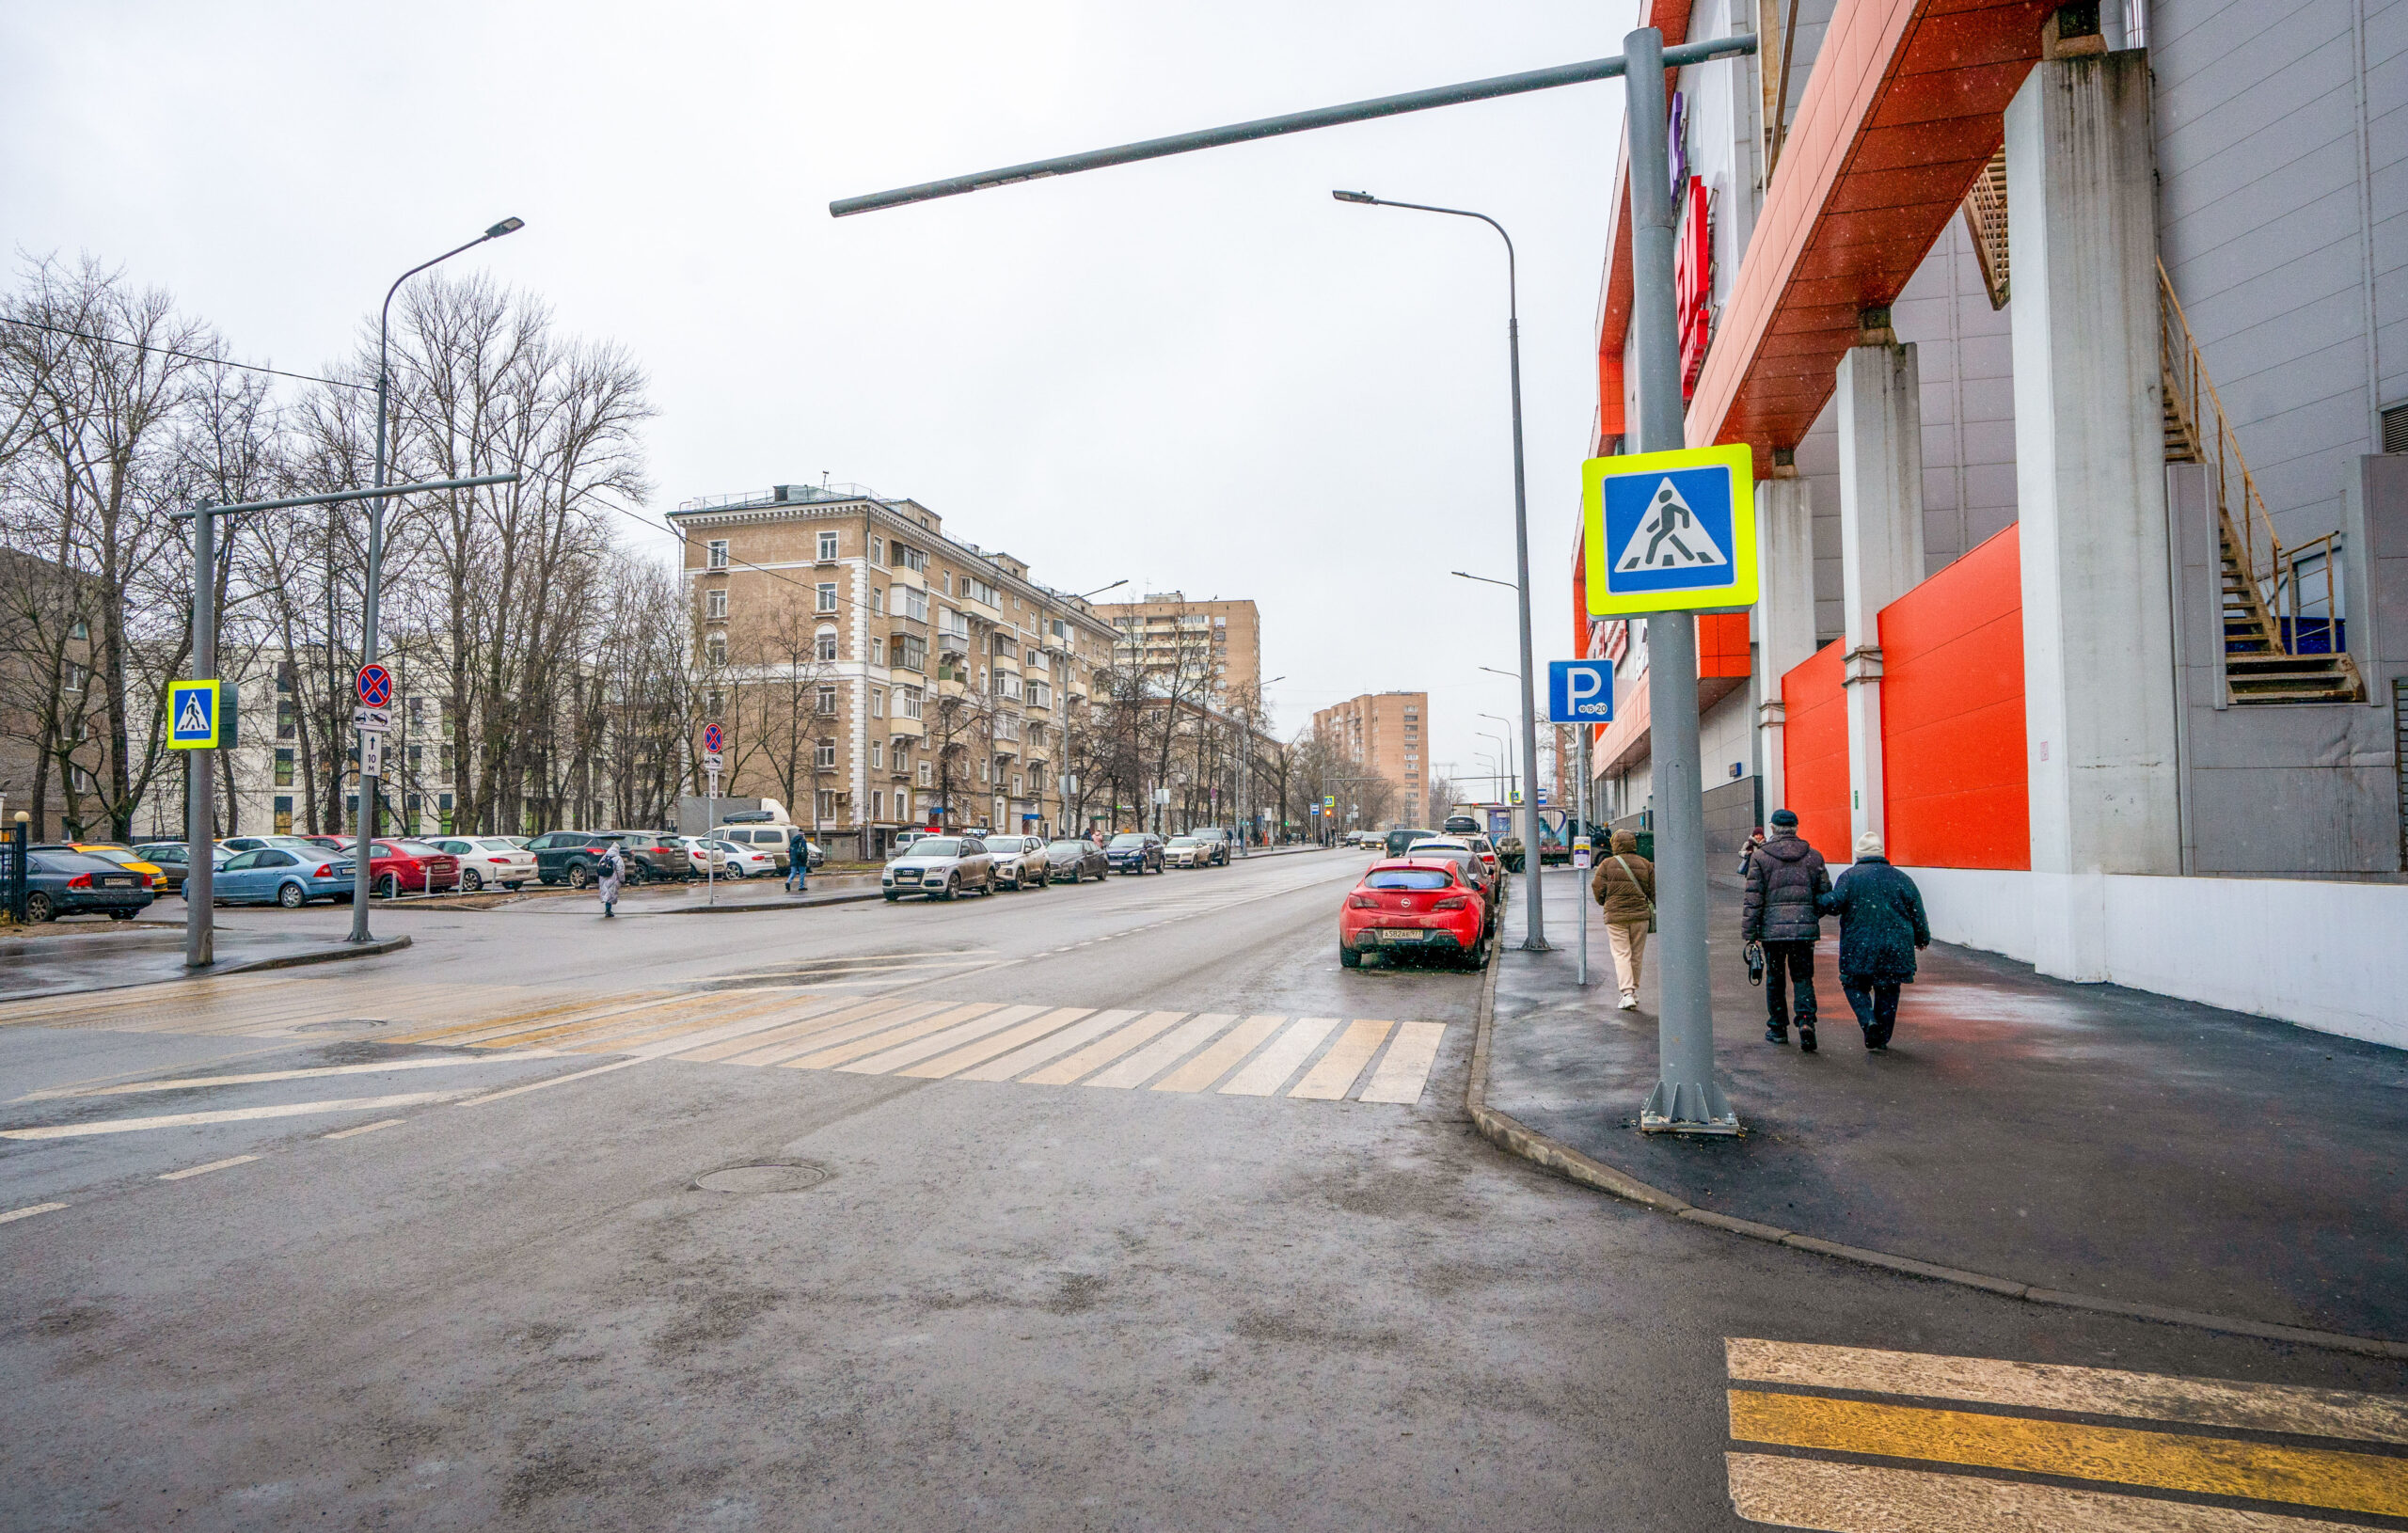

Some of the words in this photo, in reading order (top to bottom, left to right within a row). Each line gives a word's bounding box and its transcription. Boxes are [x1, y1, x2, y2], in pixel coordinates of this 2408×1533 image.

[1567, 668, 1601, 715] P
[1596, 704, 1607, 713] 20
[368, 754, 376, 763] 10
